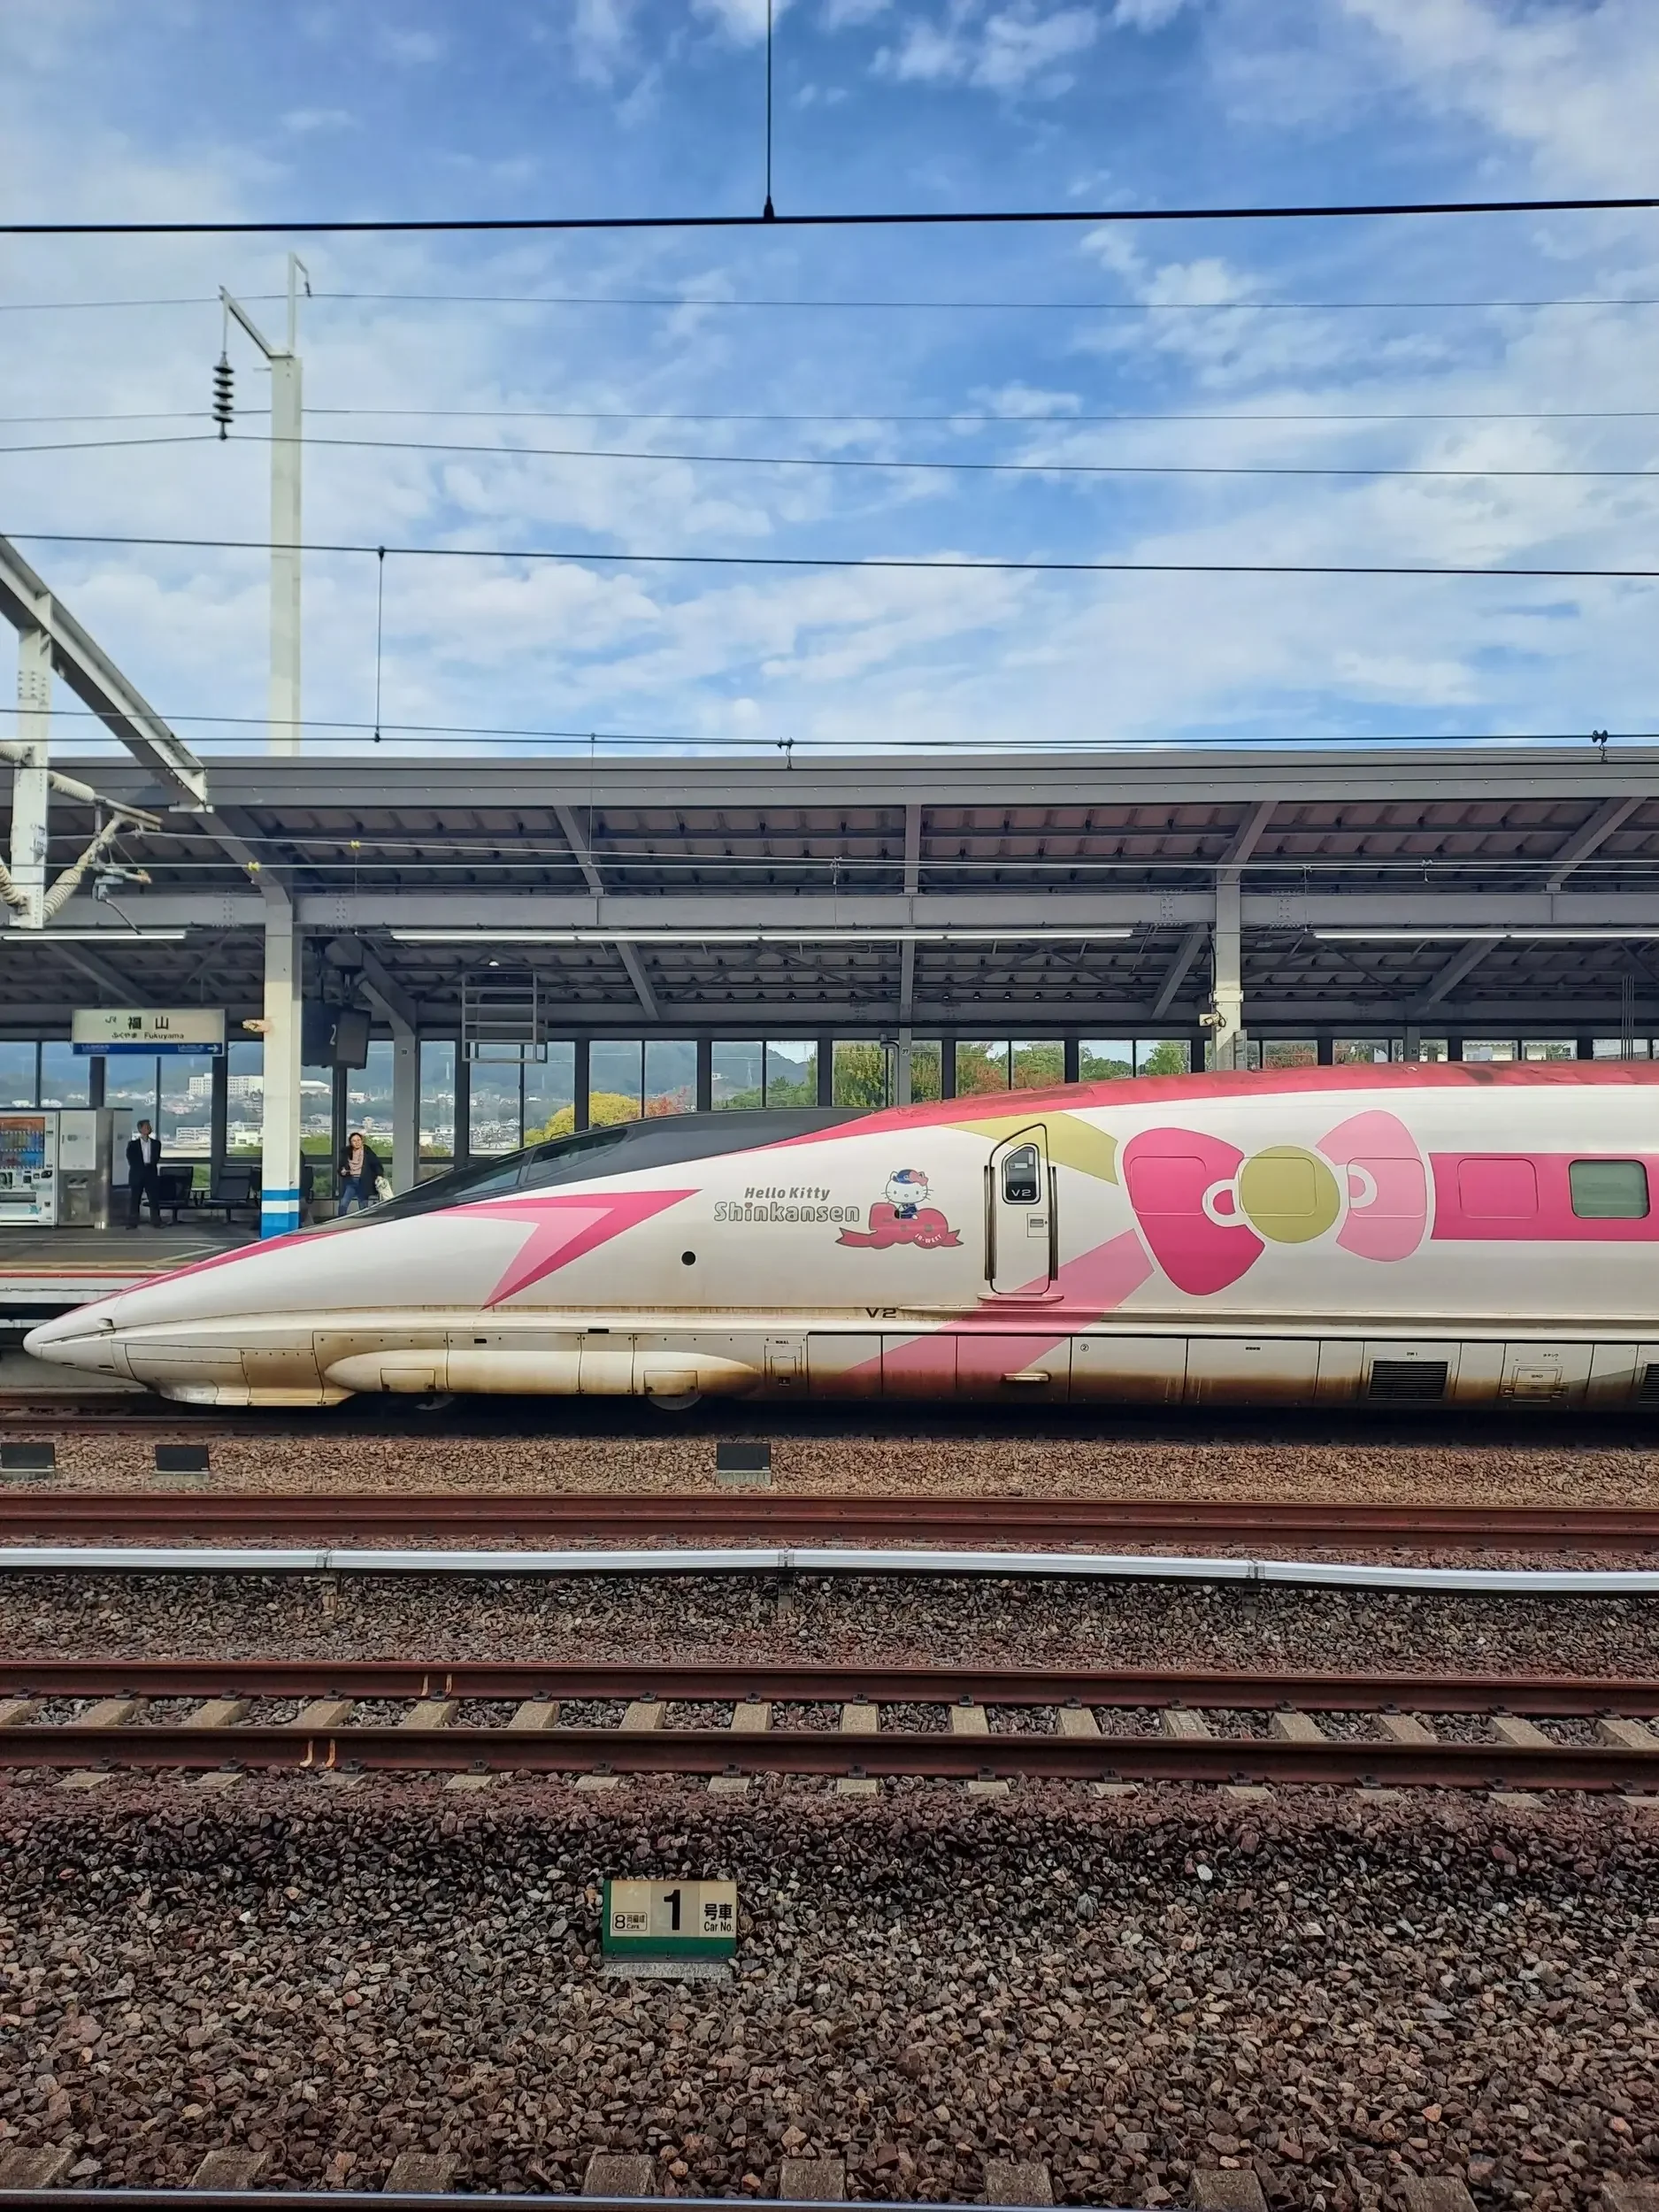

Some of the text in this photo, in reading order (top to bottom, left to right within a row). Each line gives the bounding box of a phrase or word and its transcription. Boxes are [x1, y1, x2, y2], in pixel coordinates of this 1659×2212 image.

[127, 1016, 169, 1030] 福山
[744, 1187, 830, 1201] Hello Kitty
[714, 1202, 860, 1222] Shinkansen
[866, 1308, 896, 1318] V2
[664, 1889, 680, 1931] 1
[703, 1903, 733, 1921] 号車
[615, 1915, 626, 1929] 8
[703, 1922, 734, 1932] Car No.
